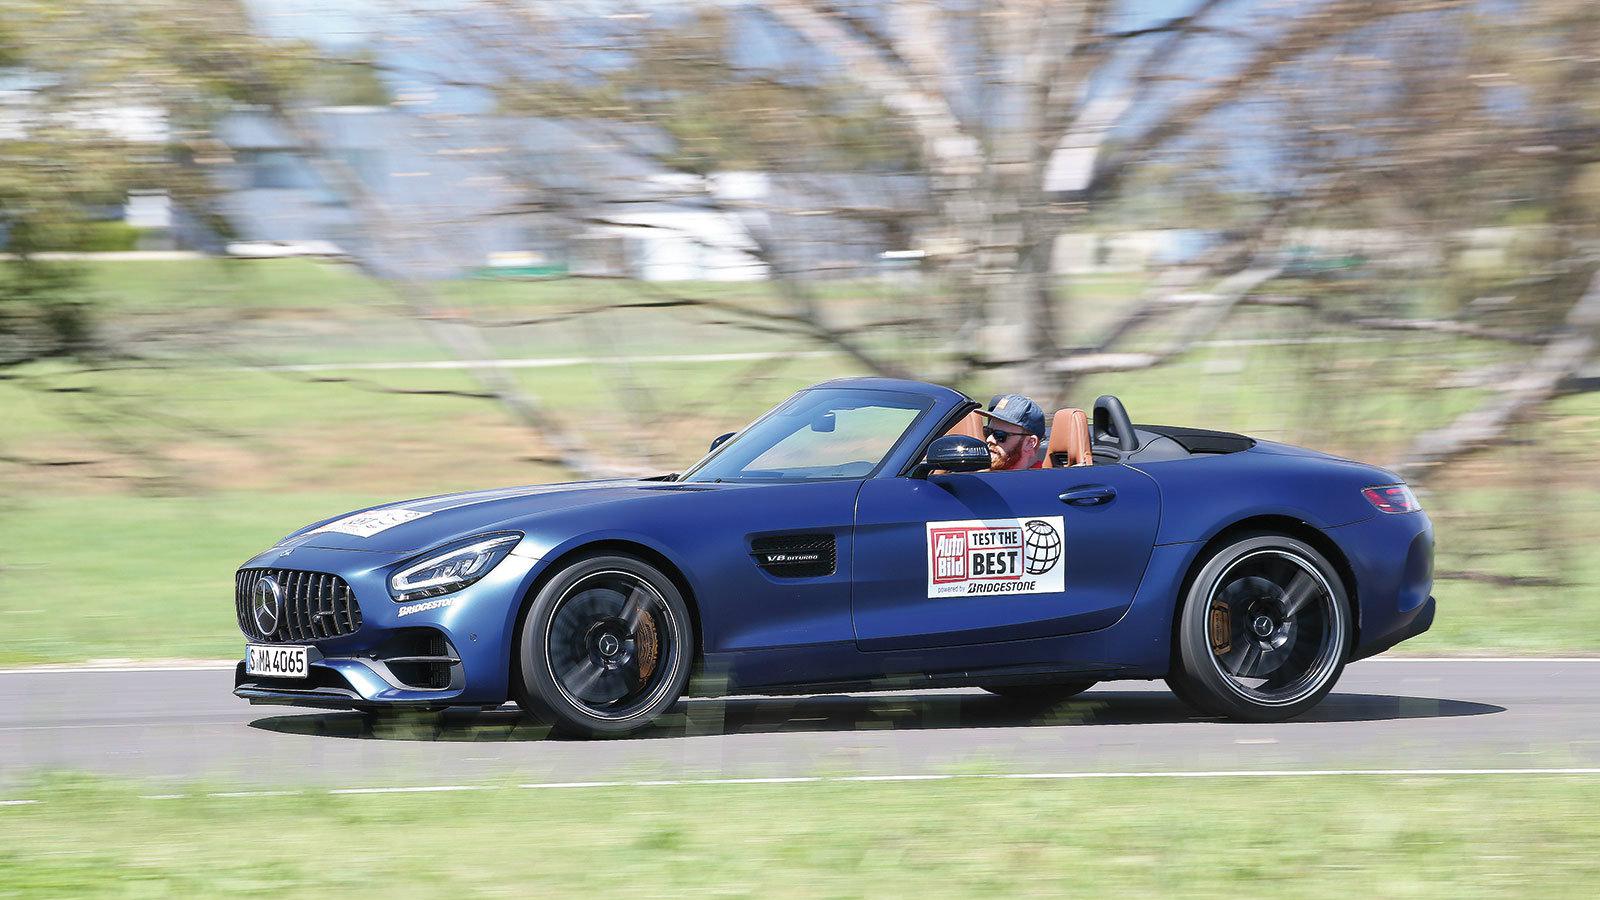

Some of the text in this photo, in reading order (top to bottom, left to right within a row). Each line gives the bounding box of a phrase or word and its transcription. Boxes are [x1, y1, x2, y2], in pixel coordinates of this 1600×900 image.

[936, 534, 965, 557] Auto
[972, 531, 1018, 546] TEST THE
[767, 554, 786, 562] V8
[937, 557, 965, 577] Bild
[972, 551, 1018, 576] BEST
[937, 581, 1037, 594] powered by BRIDGESTONE
[397, 598, 460, 618] BRIDGESTON
[273, 650, 304, 673] 4065
